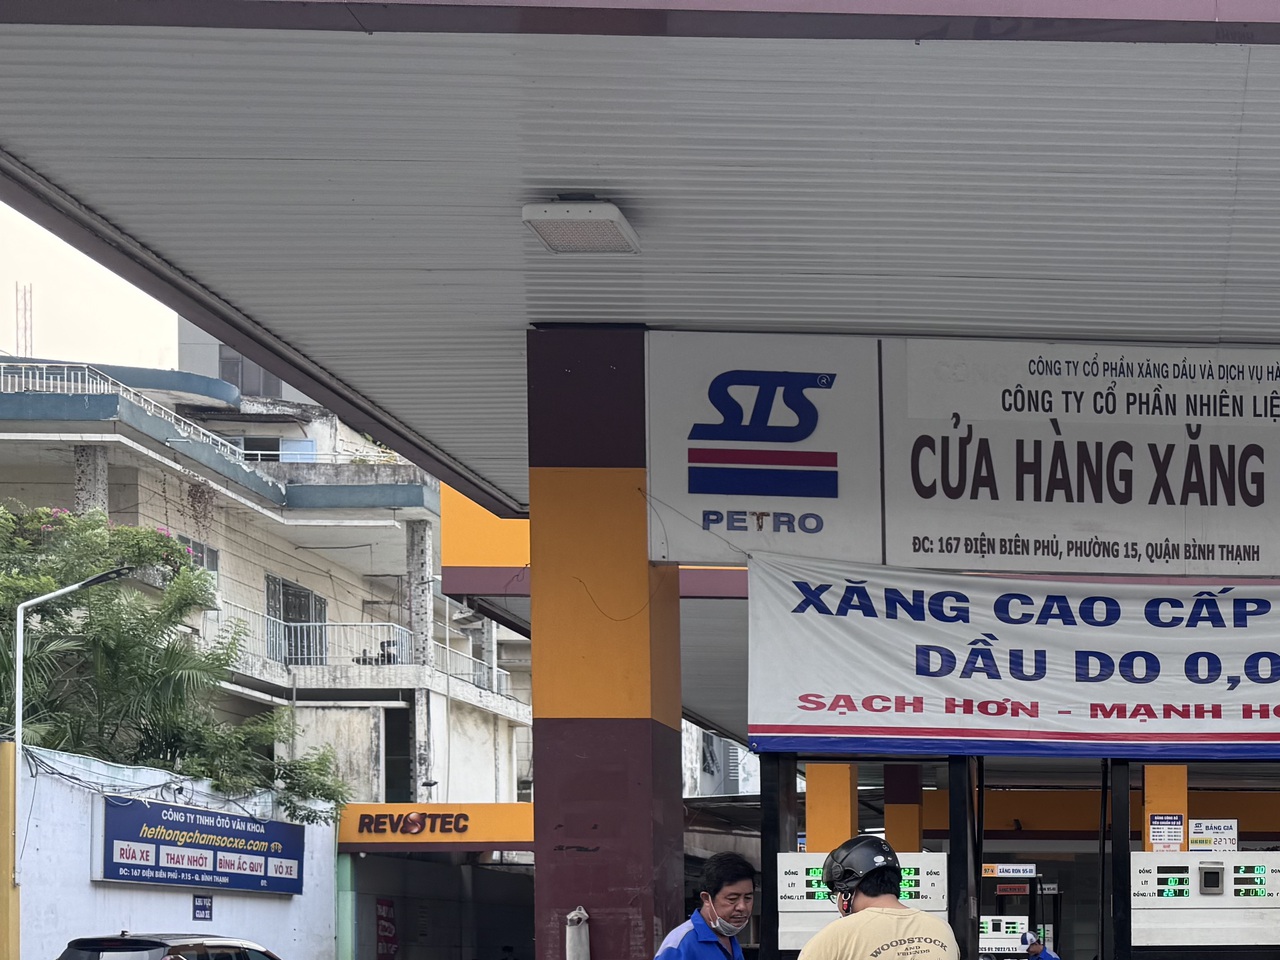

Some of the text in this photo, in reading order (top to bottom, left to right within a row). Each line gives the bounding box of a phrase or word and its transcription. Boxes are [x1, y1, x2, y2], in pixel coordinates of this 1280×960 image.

[1028, 355, 1062, 376] CÔNG
[1064, 360, 1080, 376] TY
[1083, 353, 1099, 377] CỔ
[1102, 355, 1134, 378] PHẦN
[1137, 358, 1169, 379] XĂNG
[1172, 357, 1196, 380] DẦU
[1199, 360, 1215, 380] VÀ
[1218, 363, 1245, 384] DỊCH
[1248, 365, 1263, 384] VỤ
[687, 369, 837, 443] STS
[1001, 383, 1053, 413] CÔNG
[1061, 390, 1084, 414] TY
[1092, 381, 1117, 415] CỔ
[1126, 383, 1177, 416] PHẦN
[1186, 389, 1244, 417] NHIÊN
[910, 412, 999, 501] CỬA
[1015, 418, 1134, 505] HÀNG
[1147, 422, 1265, 508] XĂNG
[702, 510, 824, 535] PETRO
[912, 532, 1260, 565] ĐC: 167 ĐIỆN BIÊN PHỦ, PHƯỜNG 15, QUẬN BÌNH THẠNH
[791, 578, 971, 624] XĂNG
[993, 592, 1122, 626] CAO
[1143, 586, 1272, 629] CẤP
[914, 632, 1047, 681] DẦU
[1074, 650, 1162, 684] DO
[796, 693, 925, 716] SẠCH
[944, 696, 1040, 719] HƠN
[1090, 702, 1223, 723] MẠNH
[161, 808, 185, 824] CÔNG
[186, 813, 196, 824] TY
[196, 814, 215, 827] TNHH
[231, 818, 246, 831] VĂN
[247, 821, 265, 833] KHOA
[1205, 823, 1222, 831] BẢNG
[139, 823, 268, 852] hethongchamsocxe.com
[119, 844, 150, 862] RỬA XE
[166, 852, 208, 868] THAY NHỚT
[218, 857, 235, 871] BÌNH
[249, 861, 263, 873] QUY
[131, 868, 141, 876] 167
[155, 870, 167, 878] BIÊN
[201, 873, 213, 882] BÌNH
[274, 861, 293, 876] VỎ XE
[870, 937, 948, 958] WOODSTOCK
